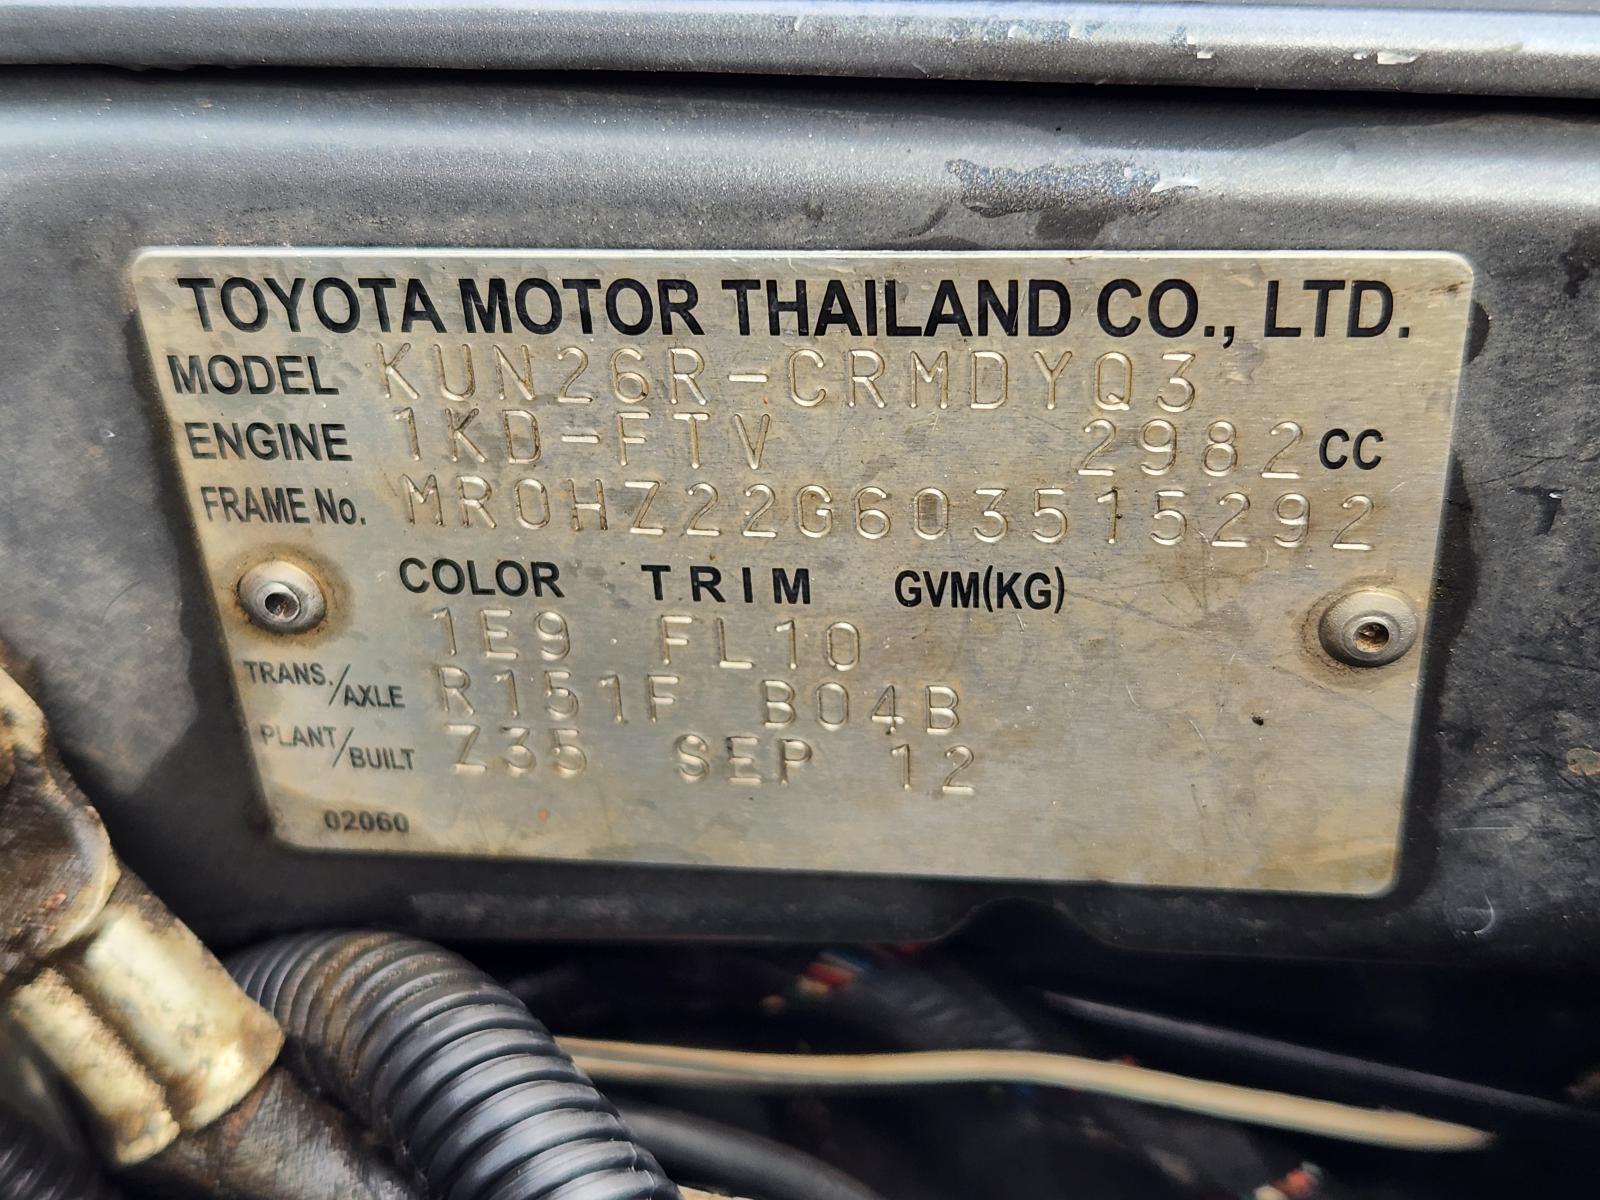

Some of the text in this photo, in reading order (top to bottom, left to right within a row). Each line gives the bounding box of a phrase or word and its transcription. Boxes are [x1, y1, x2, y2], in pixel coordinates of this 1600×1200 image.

[178, 277, 1411, 349] TOYOTA MOTOR THAILAND CO., LTD.
[167, 342, 1197, 413] MODEL KUN26R-CRMDYQ3
[187, 406, 1384, 480] ENGINE 1KD-FTV 2982 CC
[201, 485, 310, 525] FRAME
[314, 488, 367, 526] No.
[399, 557, 1065, 614] COLOR TRIM GVM(KG)
[432, 606, 862, 672] 1E9 FL10
[433, 664, 682, 724] R151F
[443, 722, 589, 779] Z35
[672, 733, 814, 788] SEP
[890, 743, 976, 797] 12
[324, 809, 410, 834] 02060
